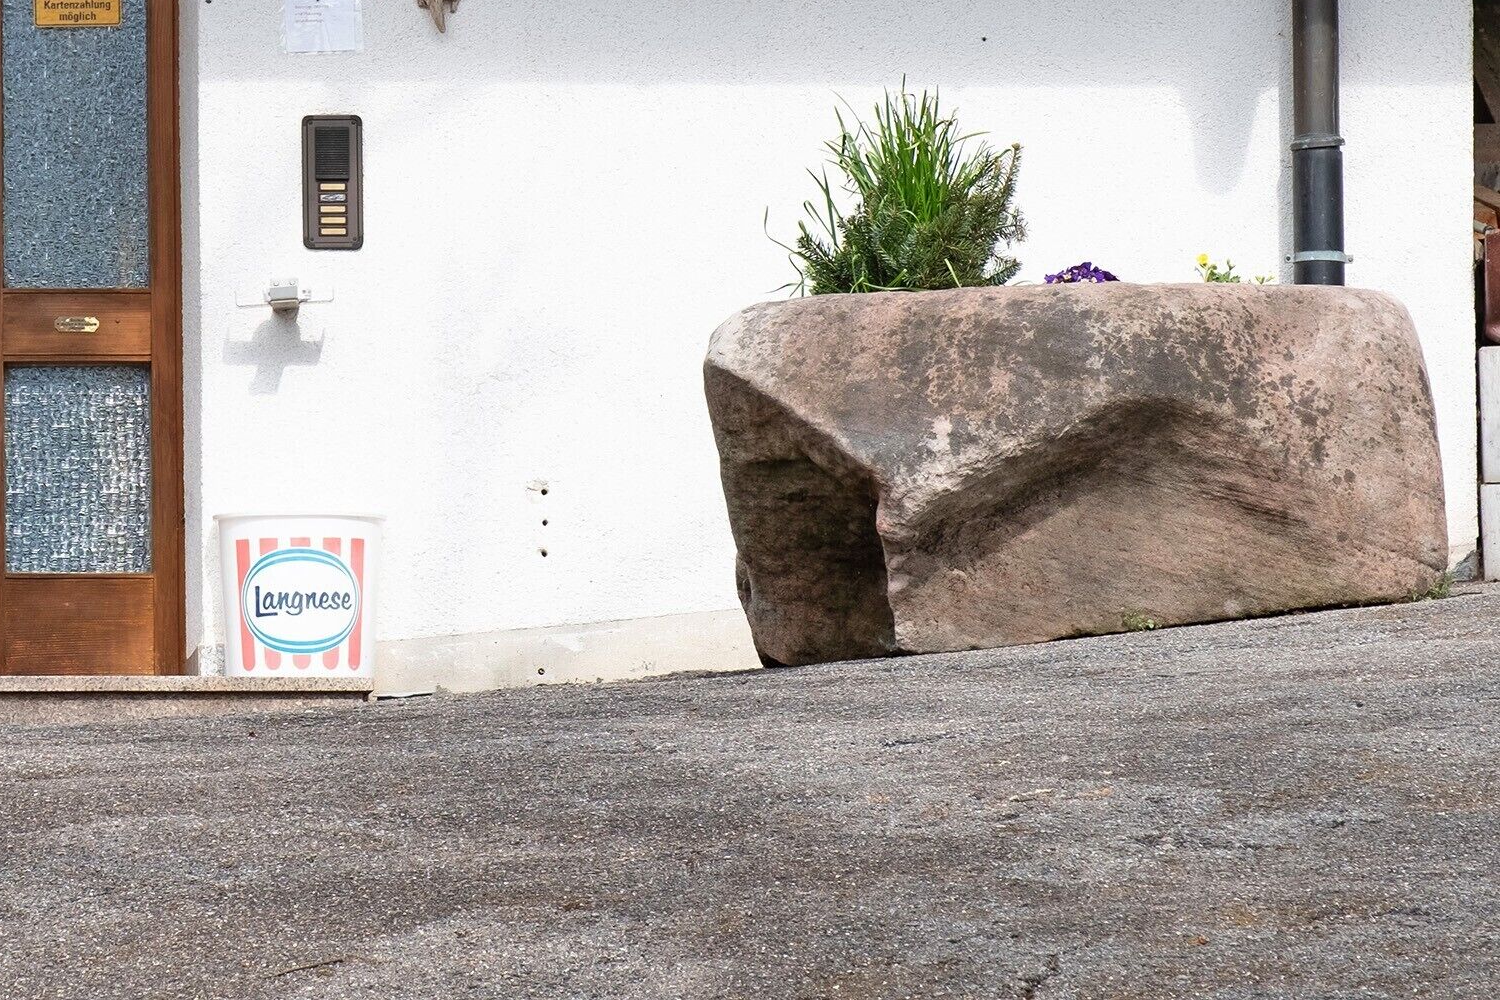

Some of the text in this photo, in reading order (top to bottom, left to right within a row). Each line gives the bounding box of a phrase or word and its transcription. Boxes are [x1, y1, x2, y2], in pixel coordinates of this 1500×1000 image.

[43, 0, 111, 11] Kartenzahlung
[59, 12, 97, 22] möglich
[254, 585, 353, 618] Langnese
